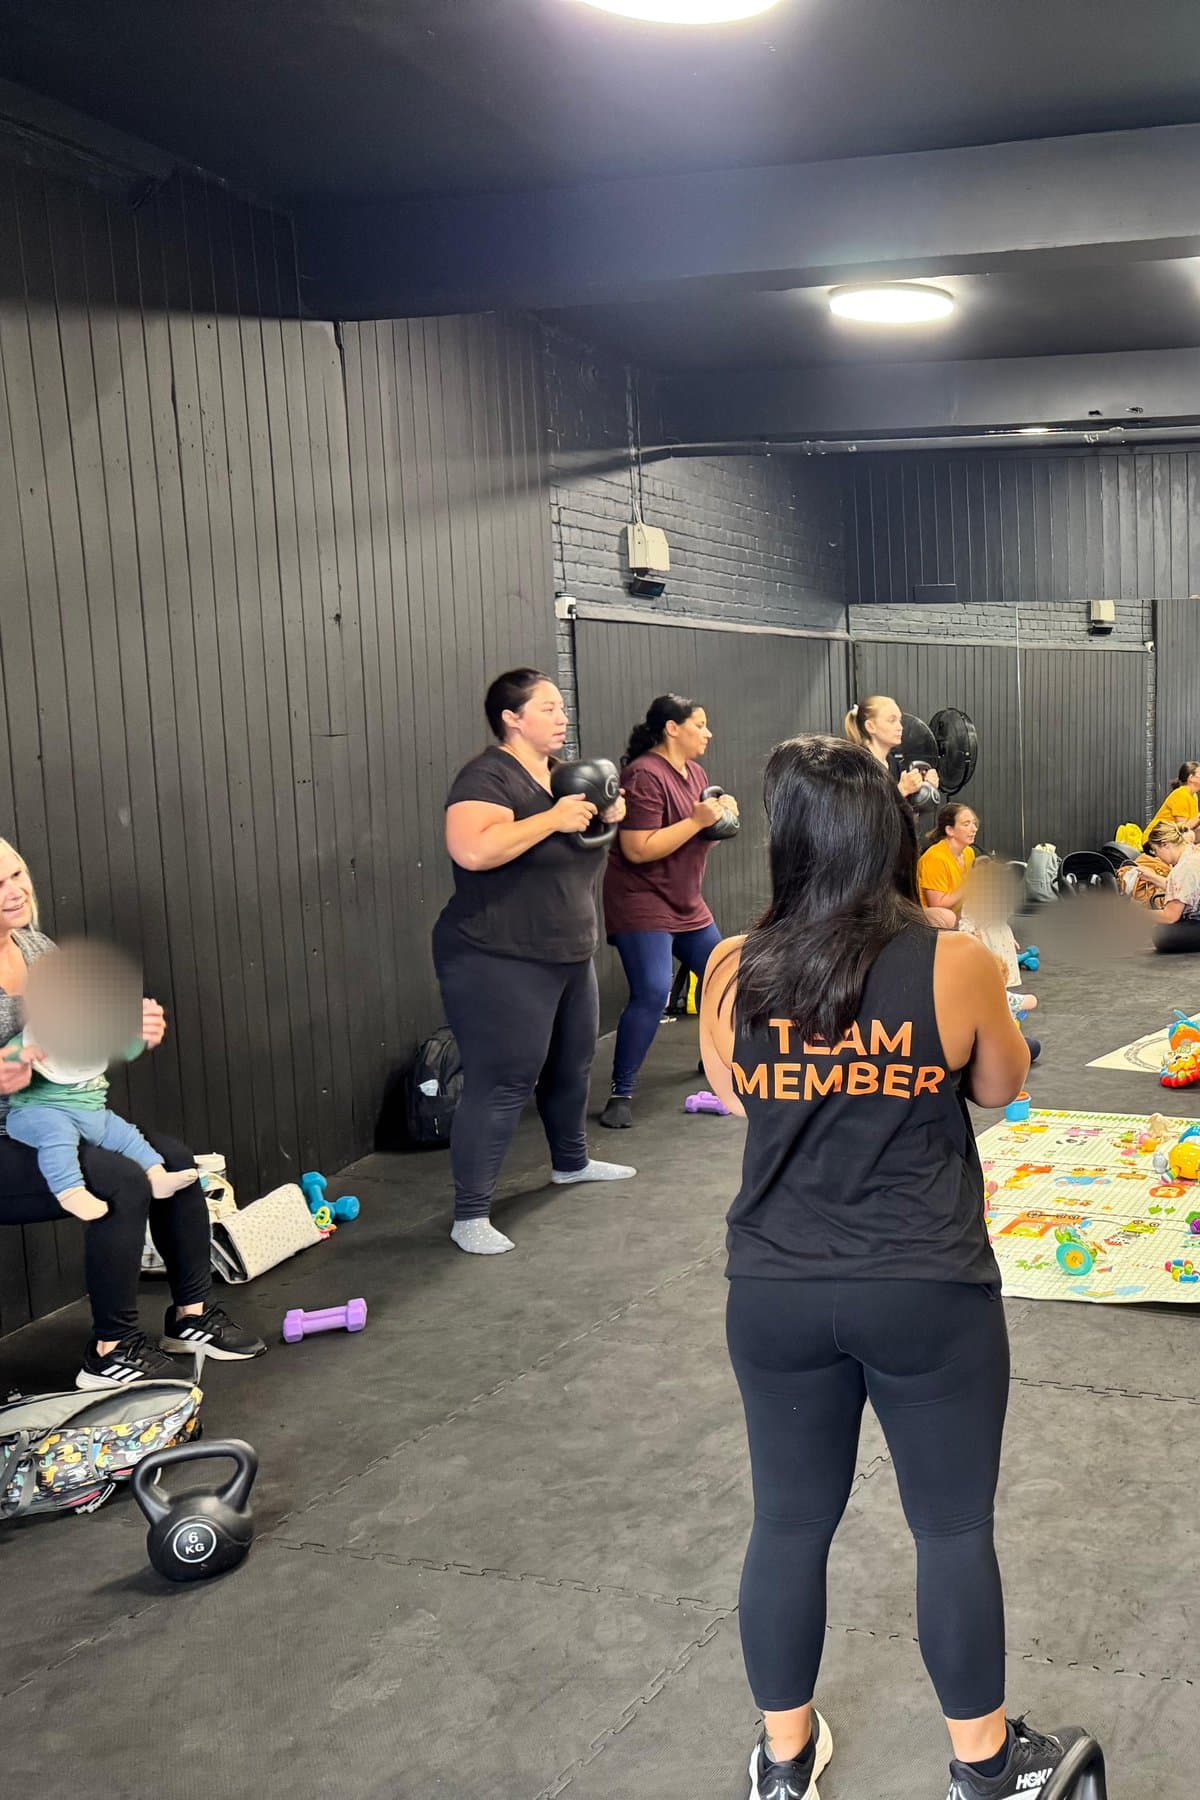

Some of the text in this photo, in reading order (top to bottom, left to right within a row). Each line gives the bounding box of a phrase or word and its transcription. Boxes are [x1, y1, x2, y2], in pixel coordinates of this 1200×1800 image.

[731, 1061, 945, 1101] MEMBER
[188, 1531, 199, 1544] 6
[185, 1543, 205, 1556] KG
